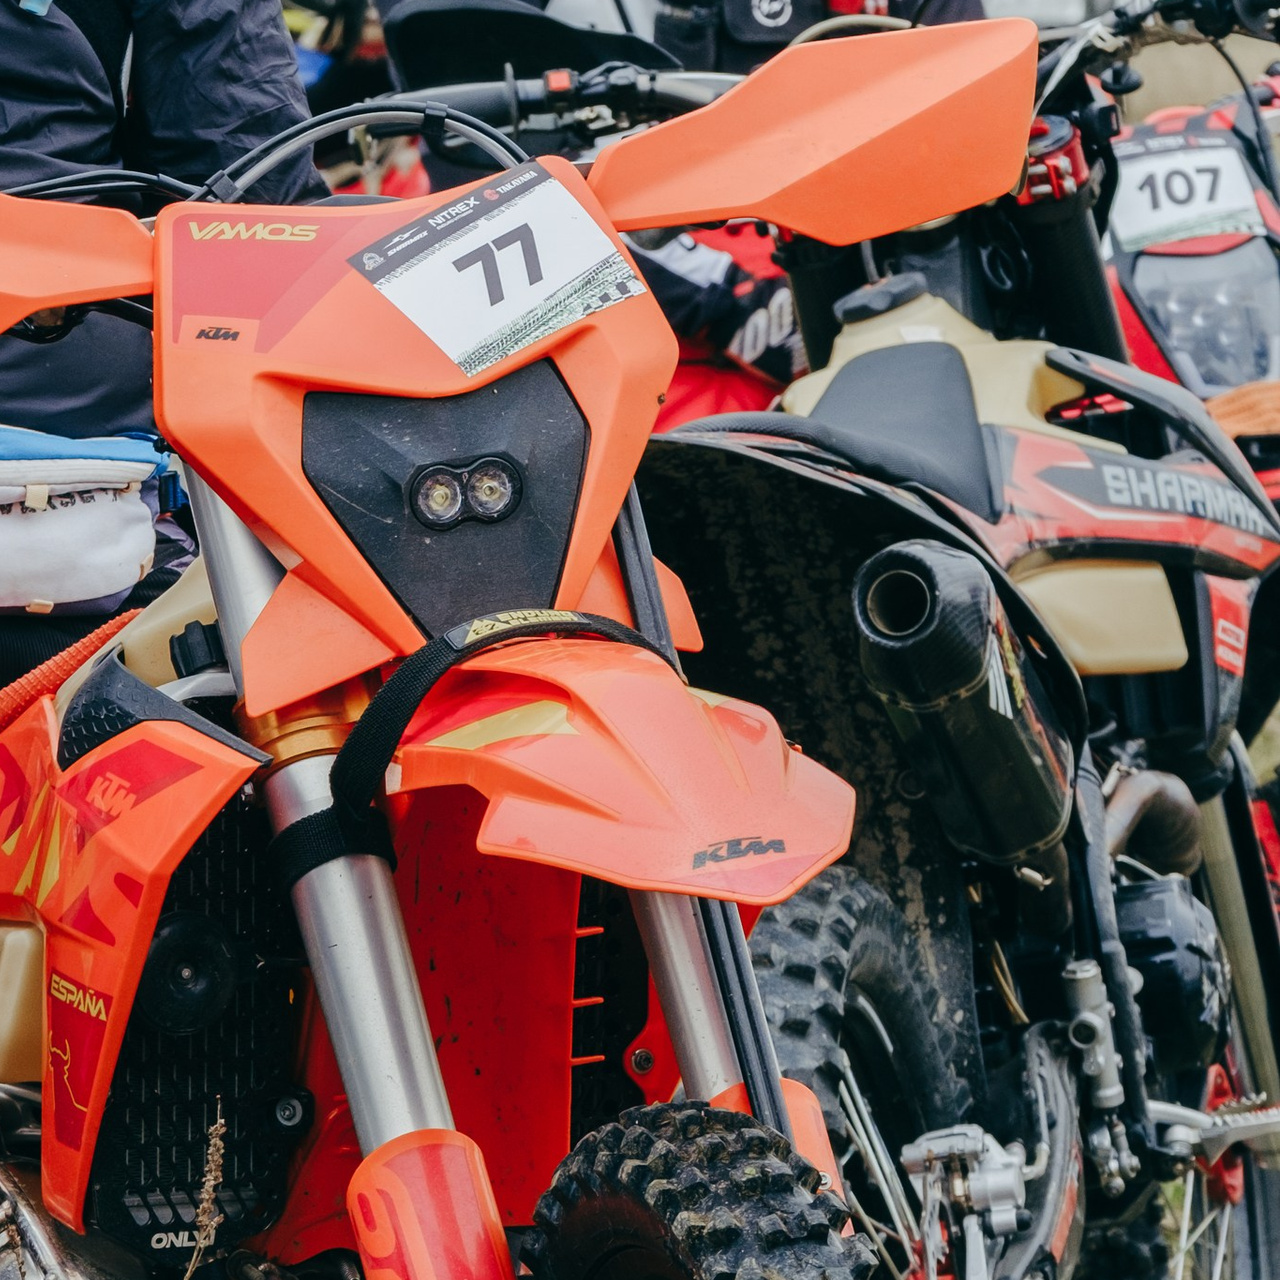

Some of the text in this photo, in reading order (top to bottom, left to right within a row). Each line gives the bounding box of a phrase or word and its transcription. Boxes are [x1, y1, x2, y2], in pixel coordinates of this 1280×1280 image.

[496, 170, 538, 195] TAKAYAMA
[1138, 167, 1221, 210] 107
[428, 196, 481, 228] NITREX
[188, 221, 320, 242] VAMOS
[452, 222, 544, 308] 77
[195, 326, 240, 342] KTM
[86, 771, 138, 821] KTM
[692, 836, 786, 870] KTM
[50, 973, 107, 1022] ESPAÑA
